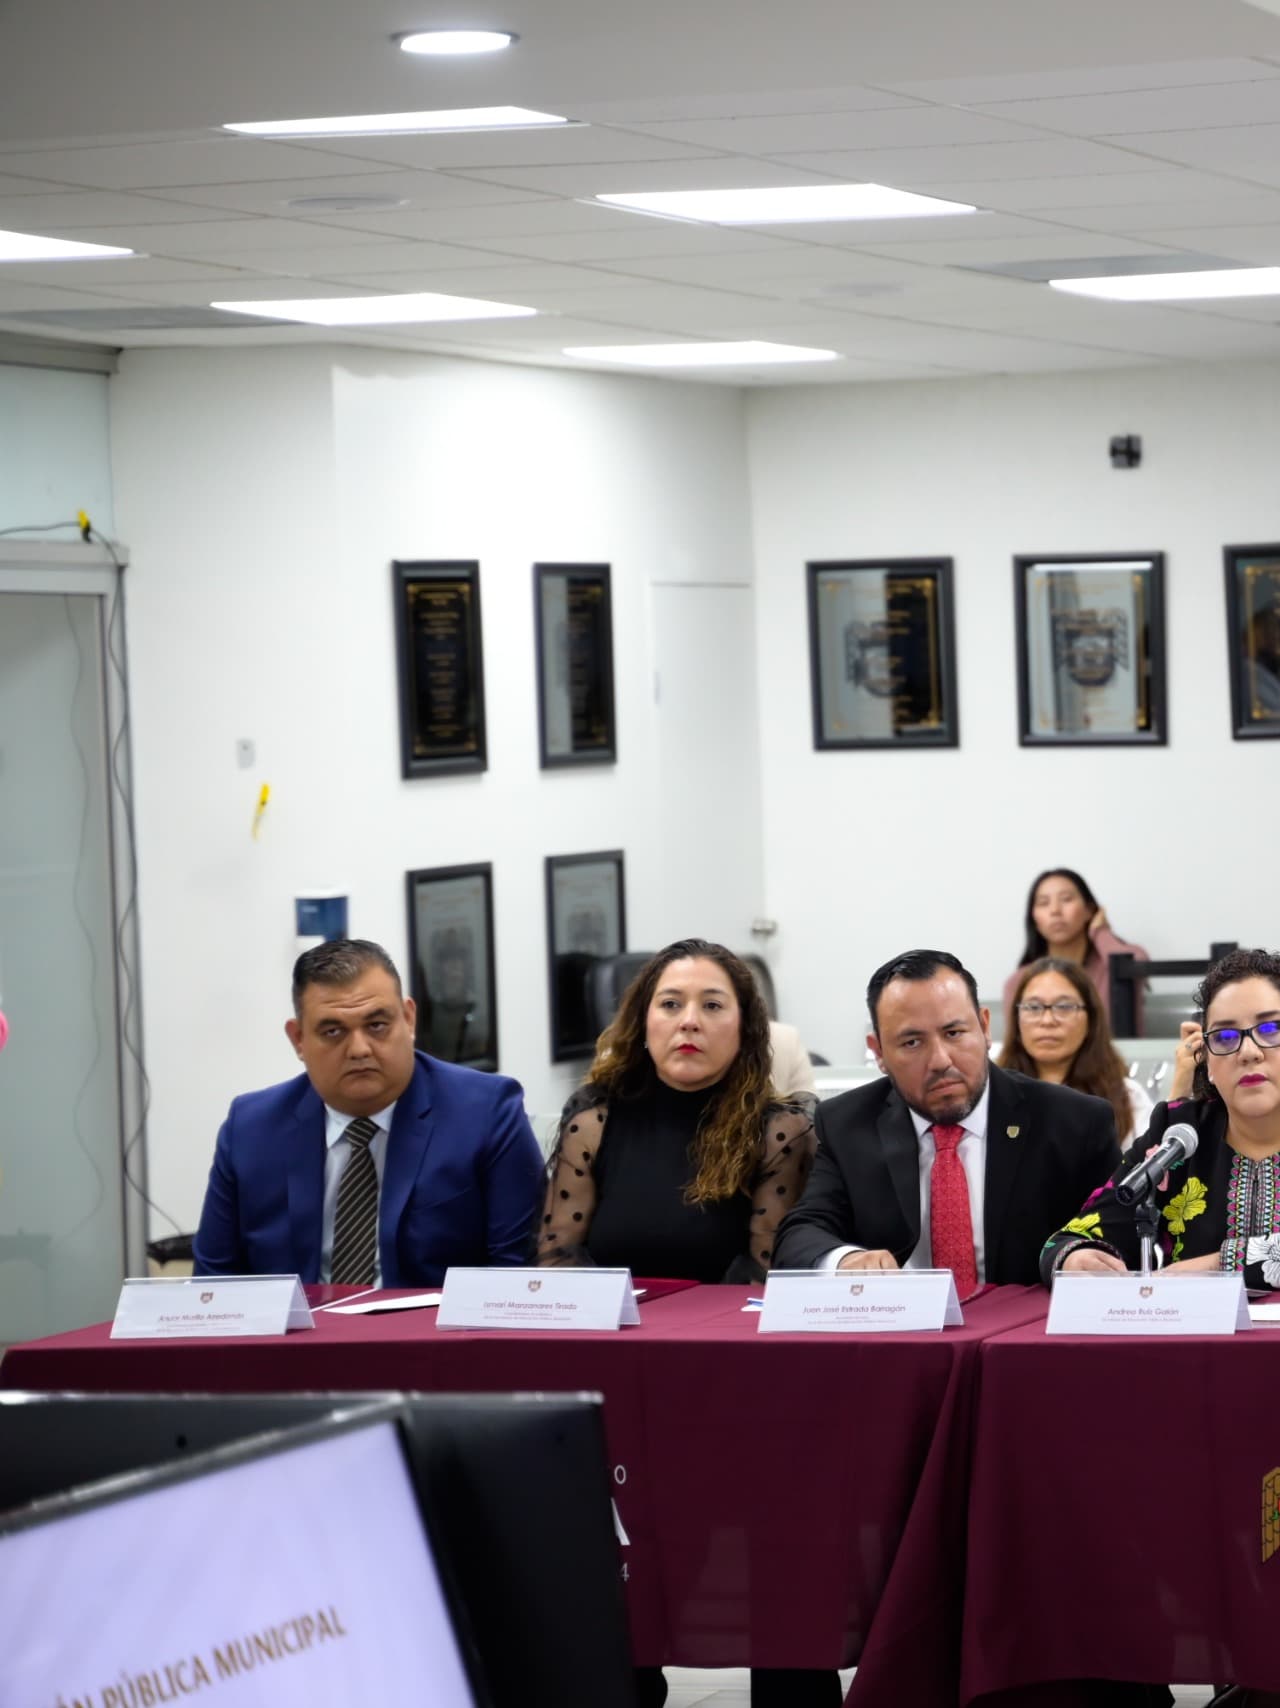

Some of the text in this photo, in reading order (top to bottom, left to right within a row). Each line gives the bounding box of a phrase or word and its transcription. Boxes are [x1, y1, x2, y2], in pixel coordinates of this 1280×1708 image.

[802, 1306, 821, 1314] Juan
[100, 1605, 347, 1708] PÚBLICA MUNICIPAL
